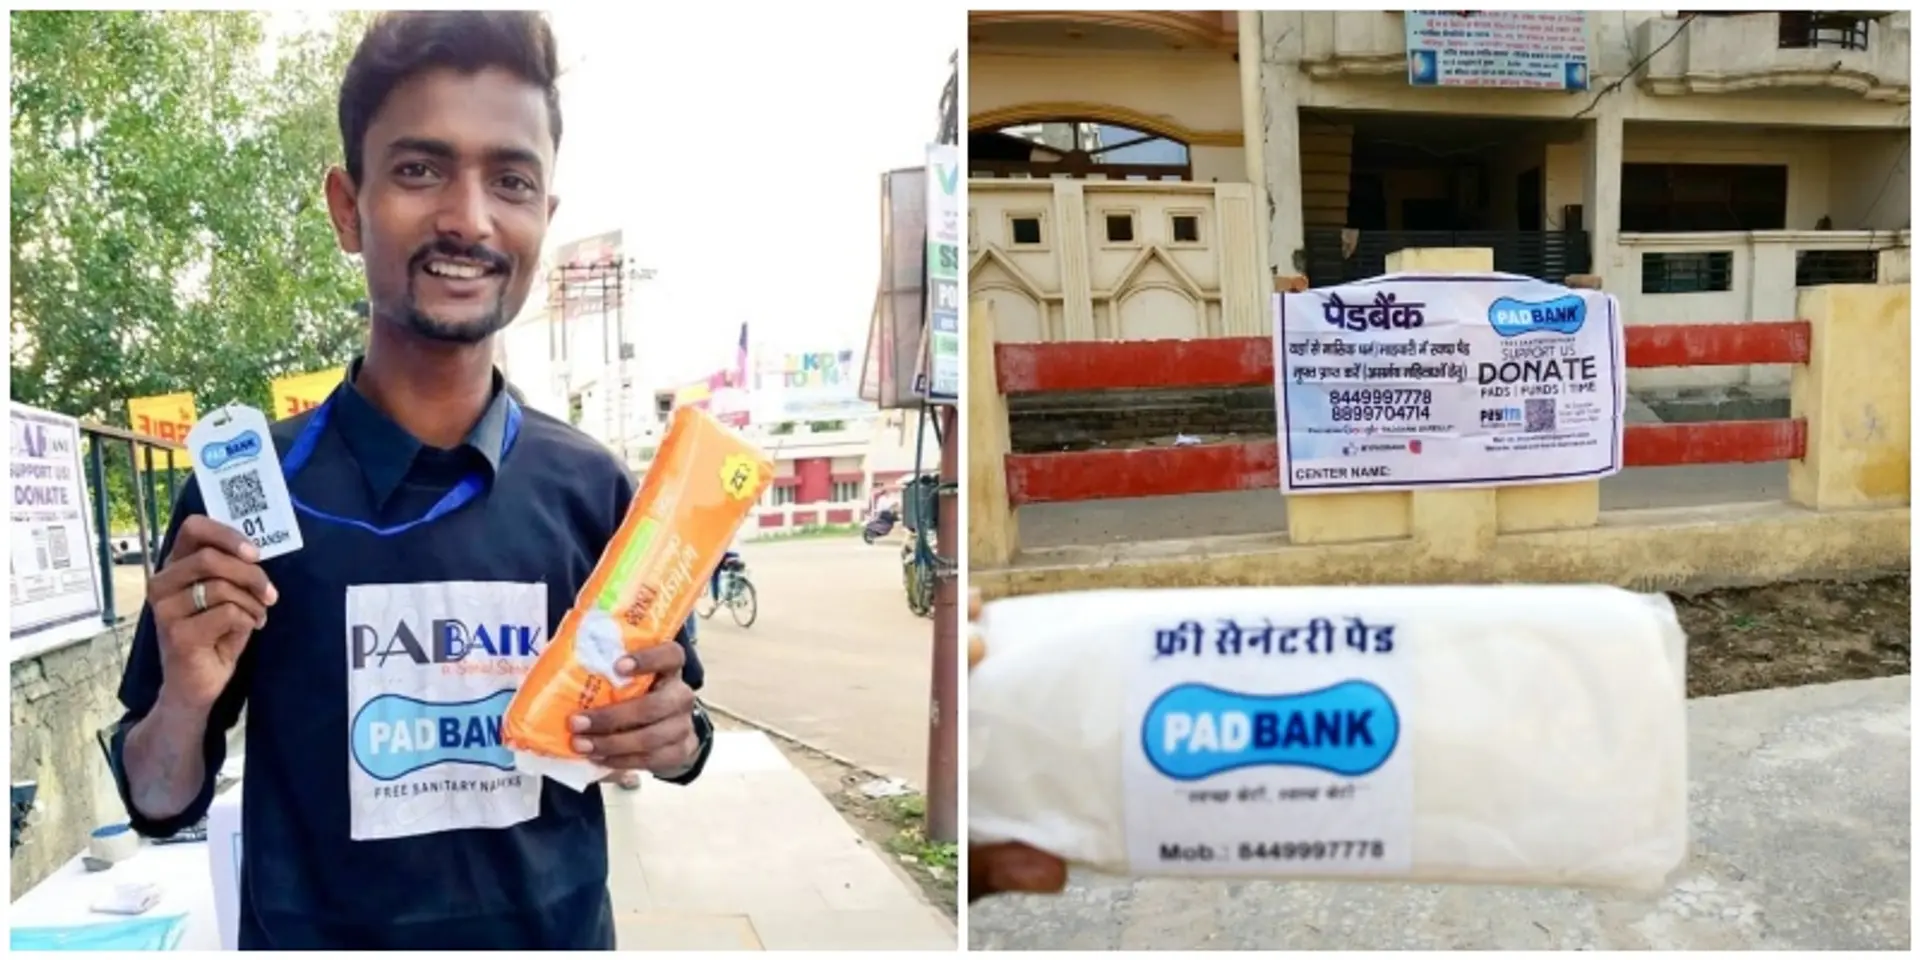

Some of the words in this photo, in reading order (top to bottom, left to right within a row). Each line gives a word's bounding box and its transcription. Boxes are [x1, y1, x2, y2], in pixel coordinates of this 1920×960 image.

[1322, 289, 1426, 332] पैडबैंक
[1497, 304, 1579, 326] PADBANK
[1479, 356, 1597, 385] DONATE
[1481, 386, 1511, 398] PADS
[1332, 406, 1430, 422] 8899704714
[1296, 467, 1347, 480] CENTER
[1351, 466, 1391, 478] NAME:
[15, 485, 69, 505] DONATE
[242, 516, 266, 536] 01
[1151, 620, 1205, 661] फ्री
[369, 713, 504, 755] PADBAN
[1163, 709, 1377, 753] PADBANK
[374, 784, 408, 799] FREE
[412, 779, 477, 796] SANITARY
[1238, 840, 1385, 861] 8449997778
